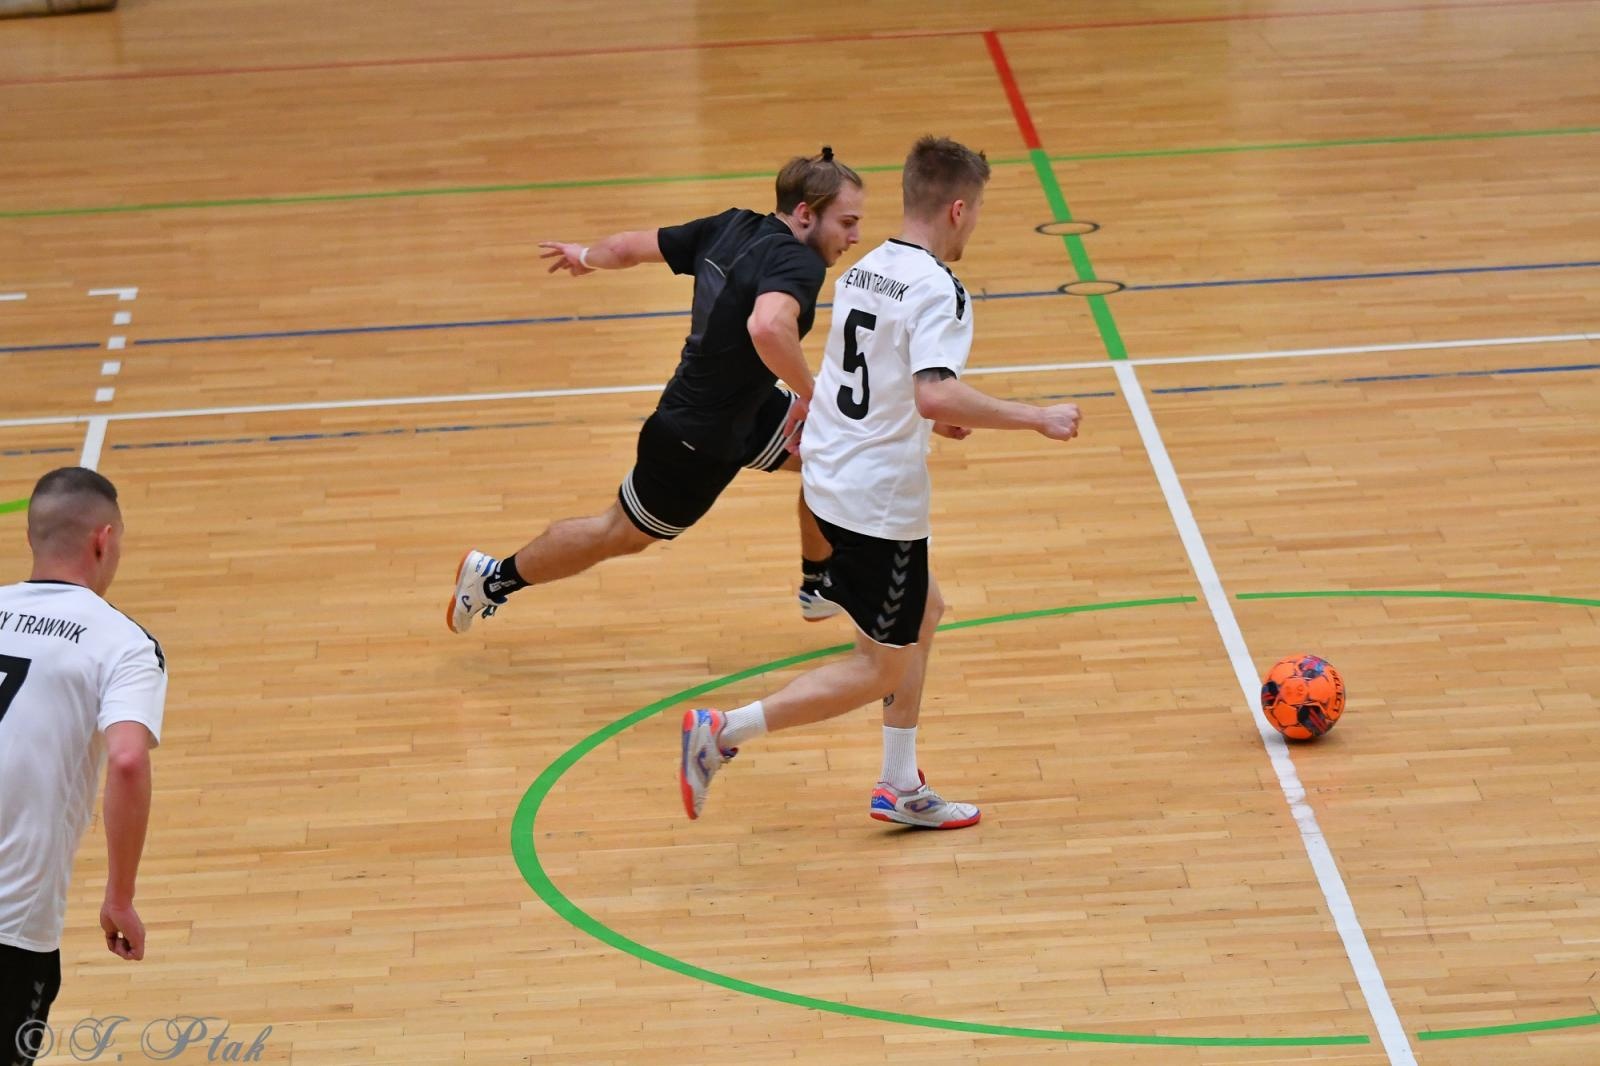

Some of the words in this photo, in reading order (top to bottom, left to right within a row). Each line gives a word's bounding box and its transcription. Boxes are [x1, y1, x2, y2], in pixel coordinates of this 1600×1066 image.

[872, 273, 910, 303] TRAWNIK
[837, 308, 877, 421] 5
[14, 614, 88, 644] TRAWNIK
